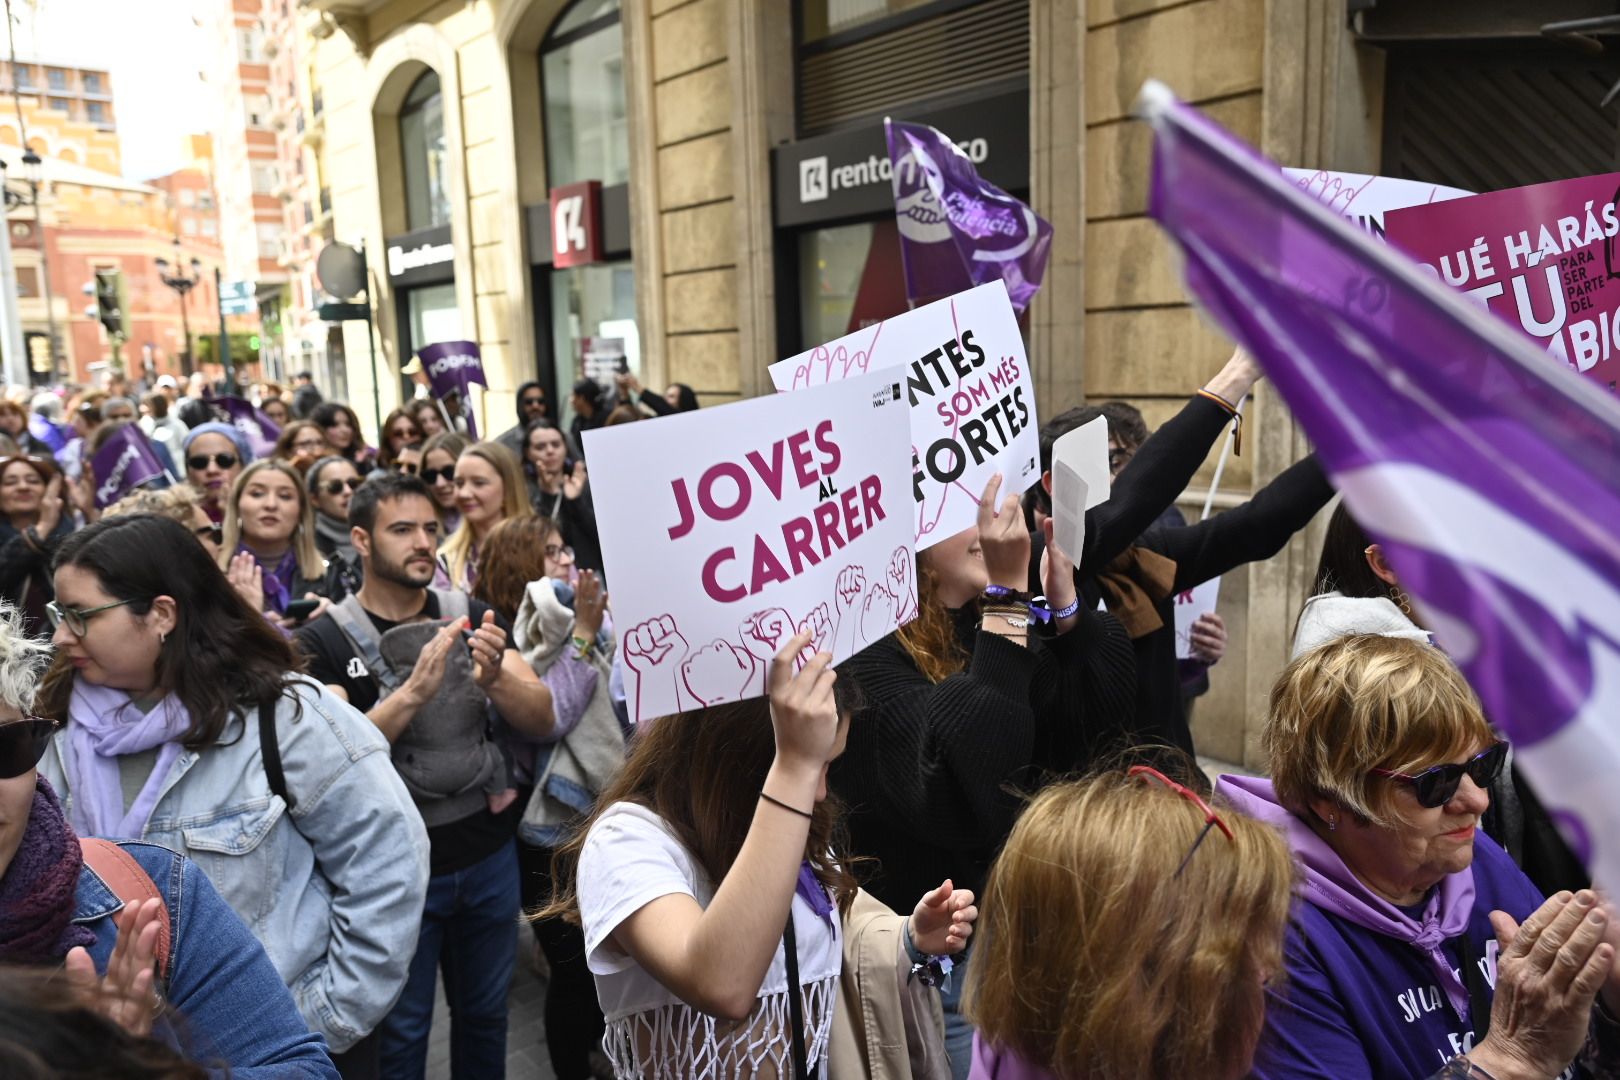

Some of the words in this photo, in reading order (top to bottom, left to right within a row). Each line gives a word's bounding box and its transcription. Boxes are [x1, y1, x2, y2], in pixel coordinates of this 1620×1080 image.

[1503, 199, 1620, 270] HARÁS
[1560, 250, 1595, 271] PARA
[1563, 267, 1588, 286] SER
[1566, 275, 1605, 300] PARTE
[1571, 295, 1594, 315] DEL
[937, 377, 990, 427] SOM
[988, 355, 1021, 394] MÉS
[912, 385, 1029, 503] FORTES
[667, 419, 842, 541] JOVES
[819, 476, 838, 502] AL
[701, 474, 887, 604] CARRER
